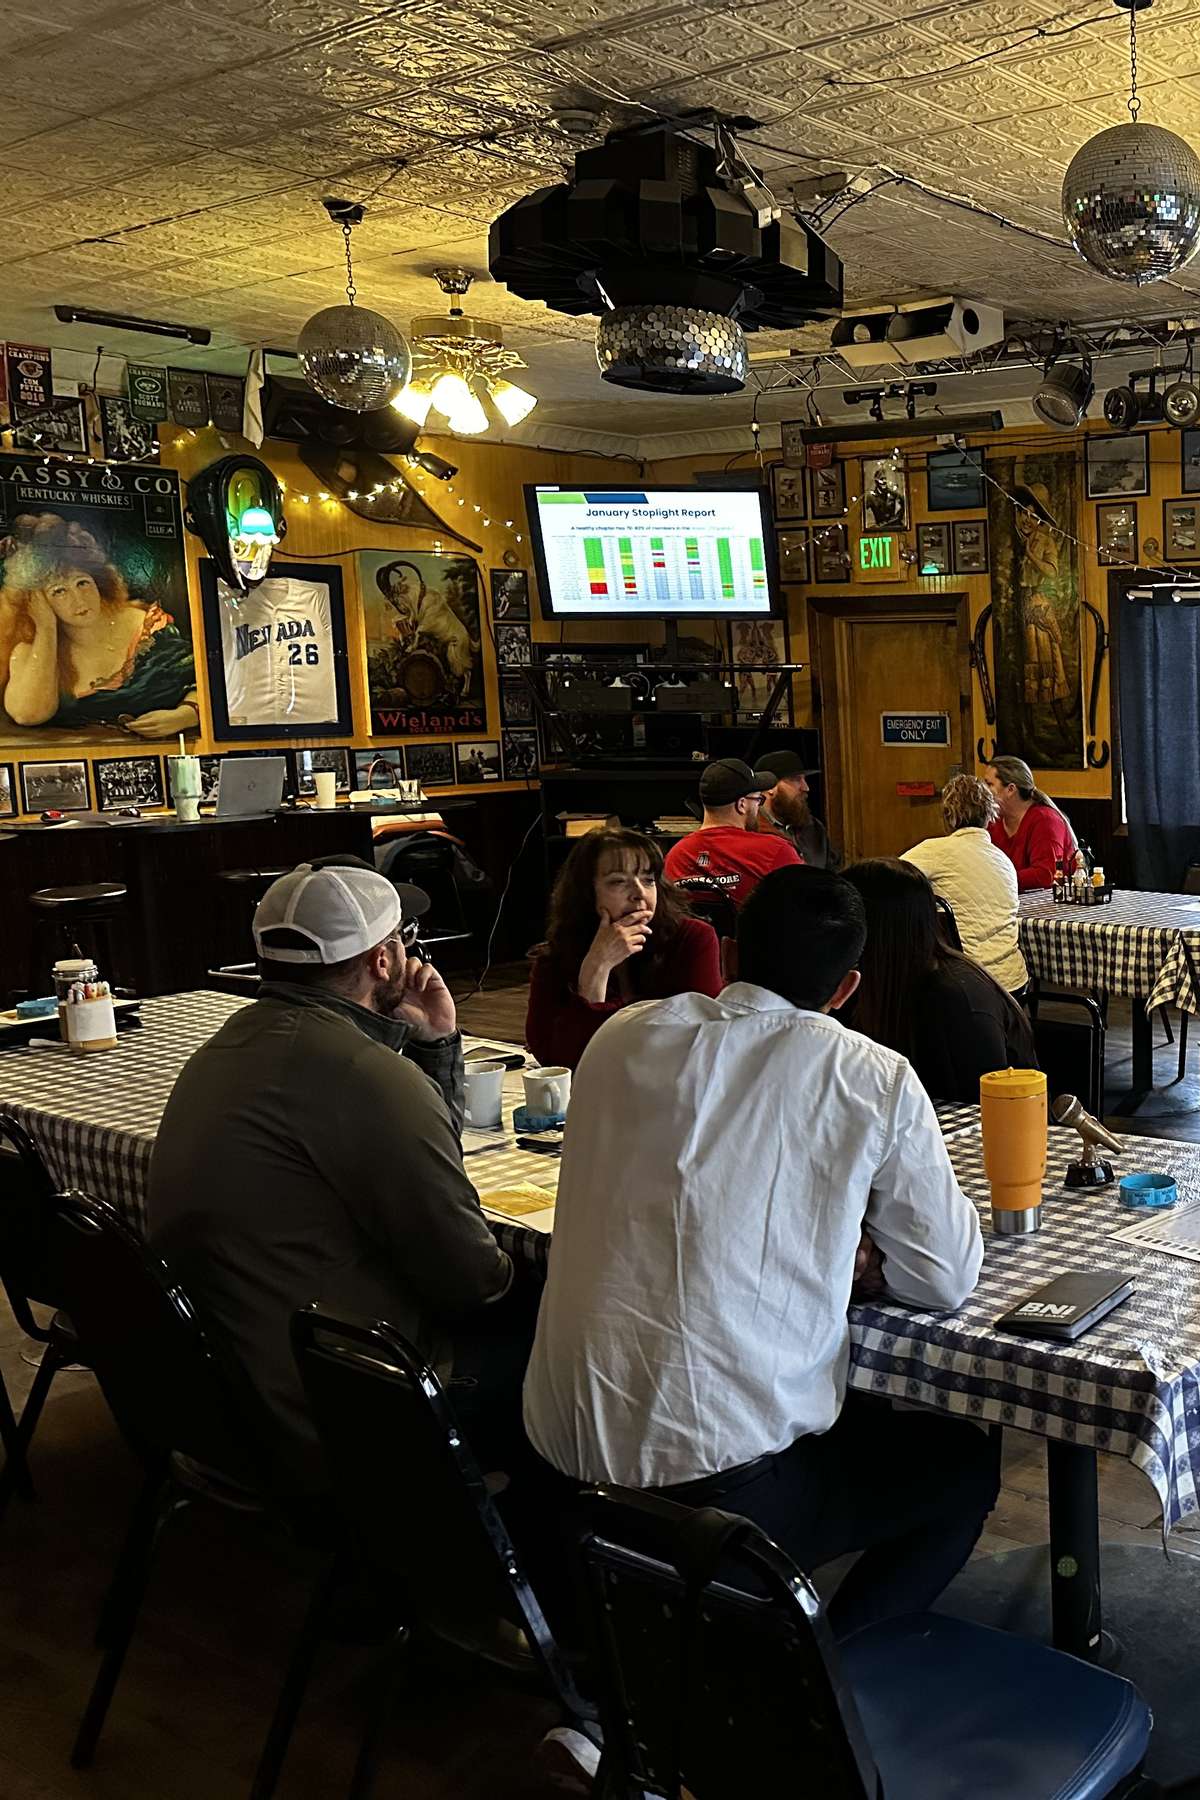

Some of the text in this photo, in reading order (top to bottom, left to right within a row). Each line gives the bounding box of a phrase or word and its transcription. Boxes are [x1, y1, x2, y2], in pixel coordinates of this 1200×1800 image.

[0, 464, 90, 488] ASSY
[134, 476, 178, 495] CO.
[20, 487, 130, 506] KENTUCKY WHISKIES
[586, 508, 716, 519] January Stoplight Report
[859, 536, 892, 569] EXIT
[235, 619, 315, 660] NEVADA
[287, 643, 319, 666] 26
[378, 711, 483, 729] Wieland's
[887, 719, 941, 730] EMERGENCY EXIT
[900, 730, 927, 740] ONLY
[1018, 1302, 1077, 1316] BNI
